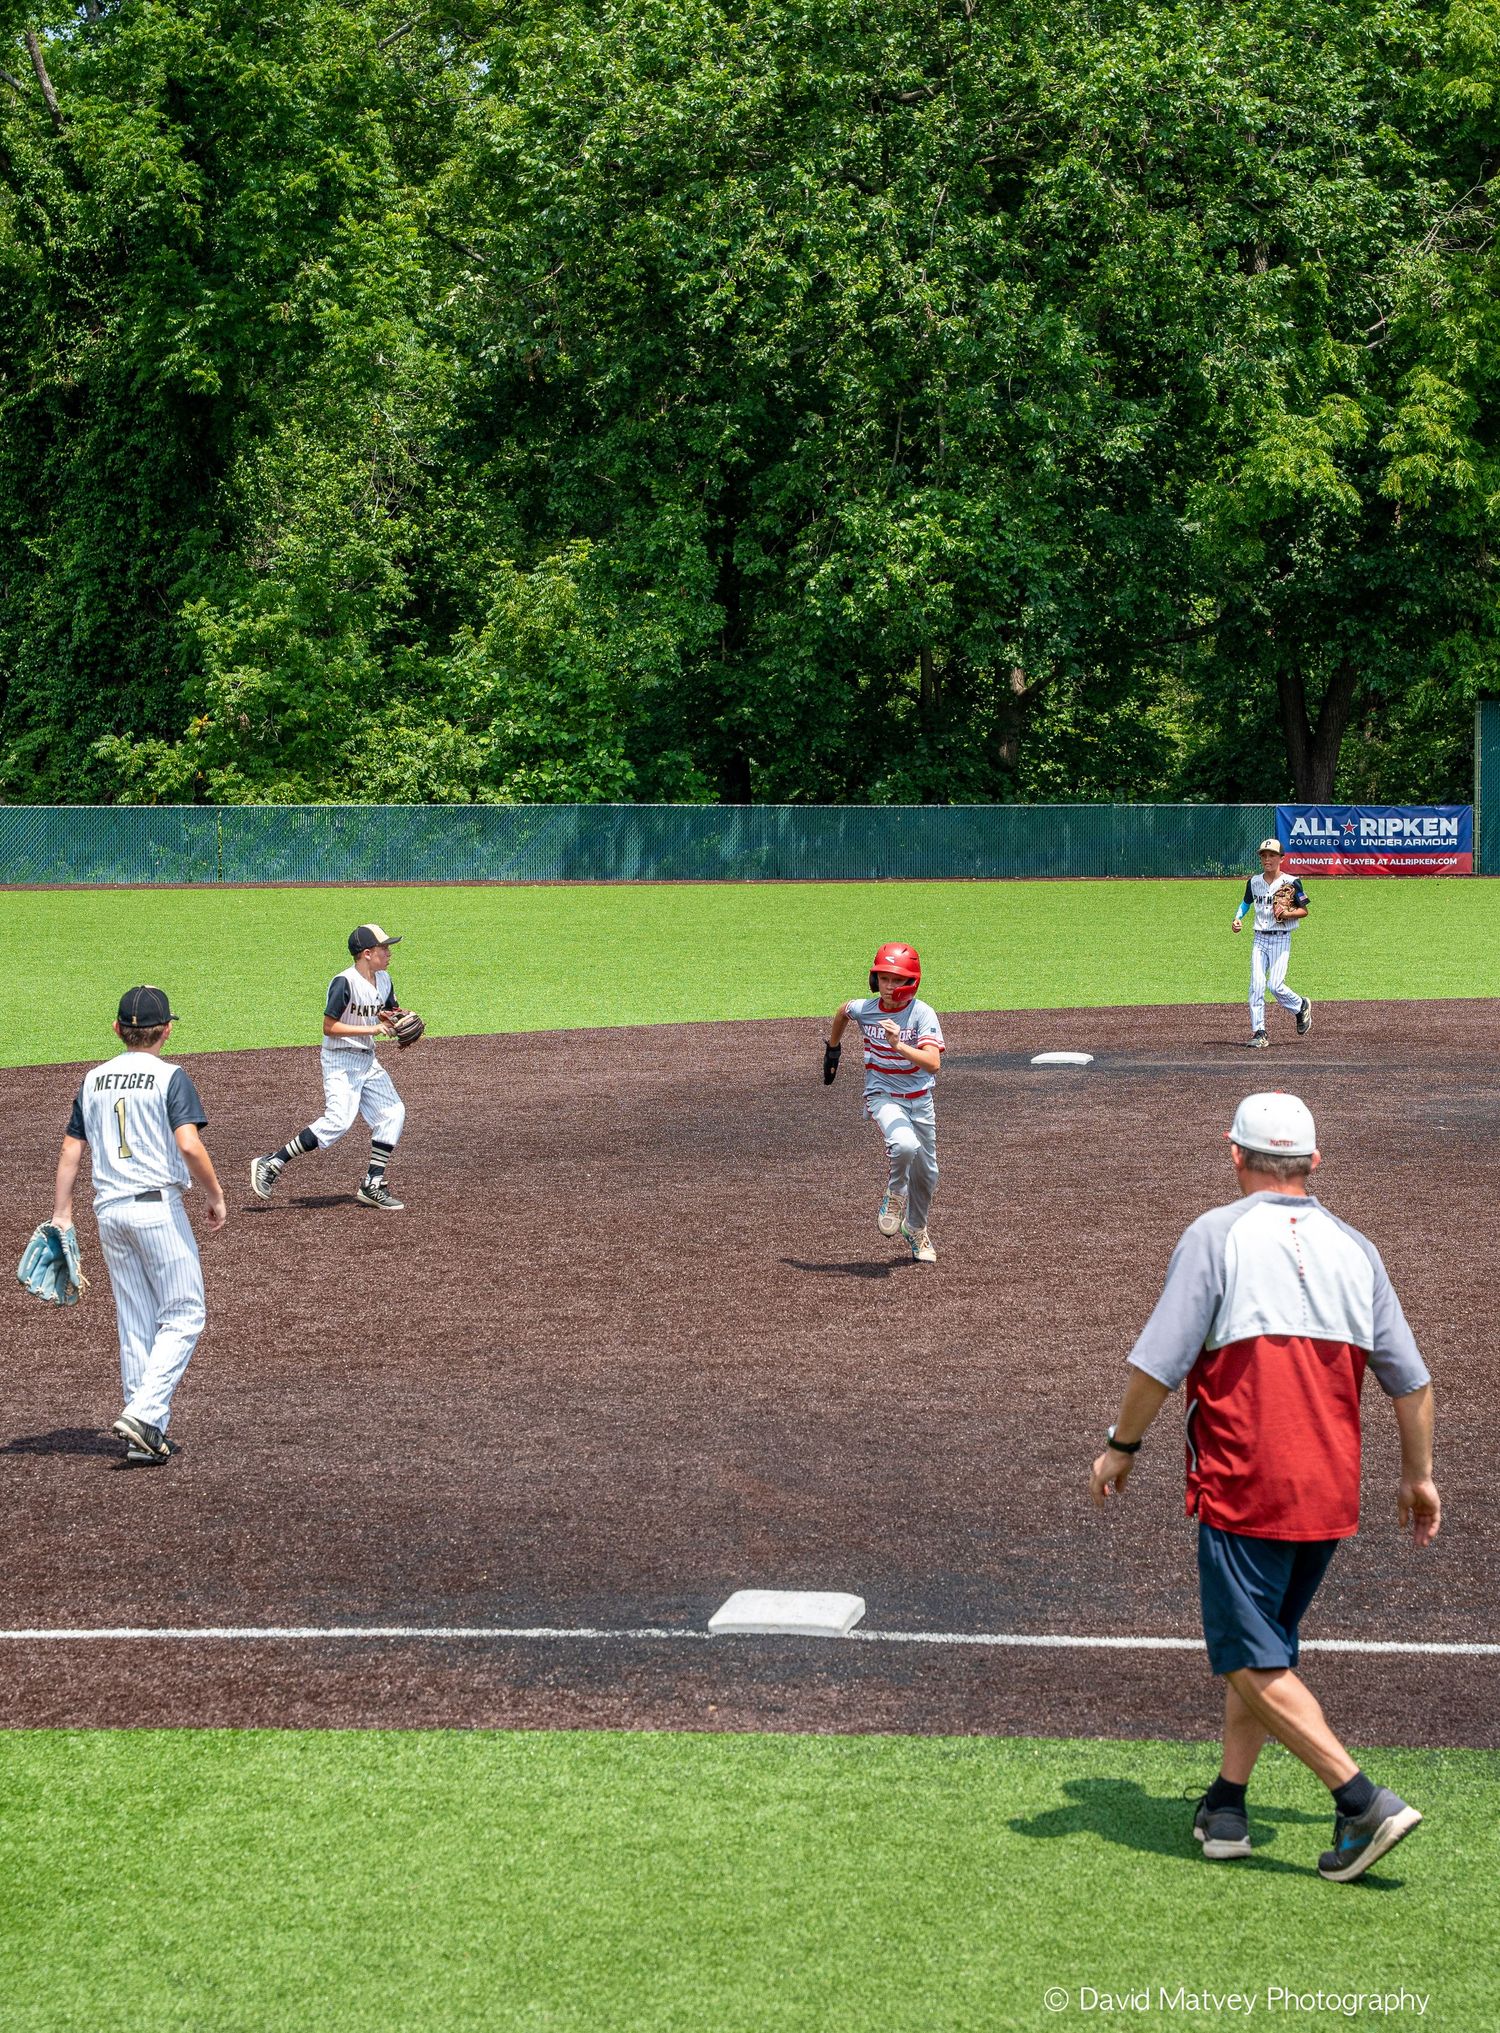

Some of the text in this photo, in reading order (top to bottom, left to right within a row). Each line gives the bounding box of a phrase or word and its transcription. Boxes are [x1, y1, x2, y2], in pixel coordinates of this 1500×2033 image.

[1290, 817, 1458, 836] ALL RIPKEN
[1289, 838, 1457, 846] POWERED BY UNDER ARMOUR
[1343, 858, 1375, 866] PLAYER
[1389, 858, 1457, 866] ALLRIPKEN.COM
[93, 1073, 155, 1092] METZGER
[113, 1097, 132, 1159] 1
